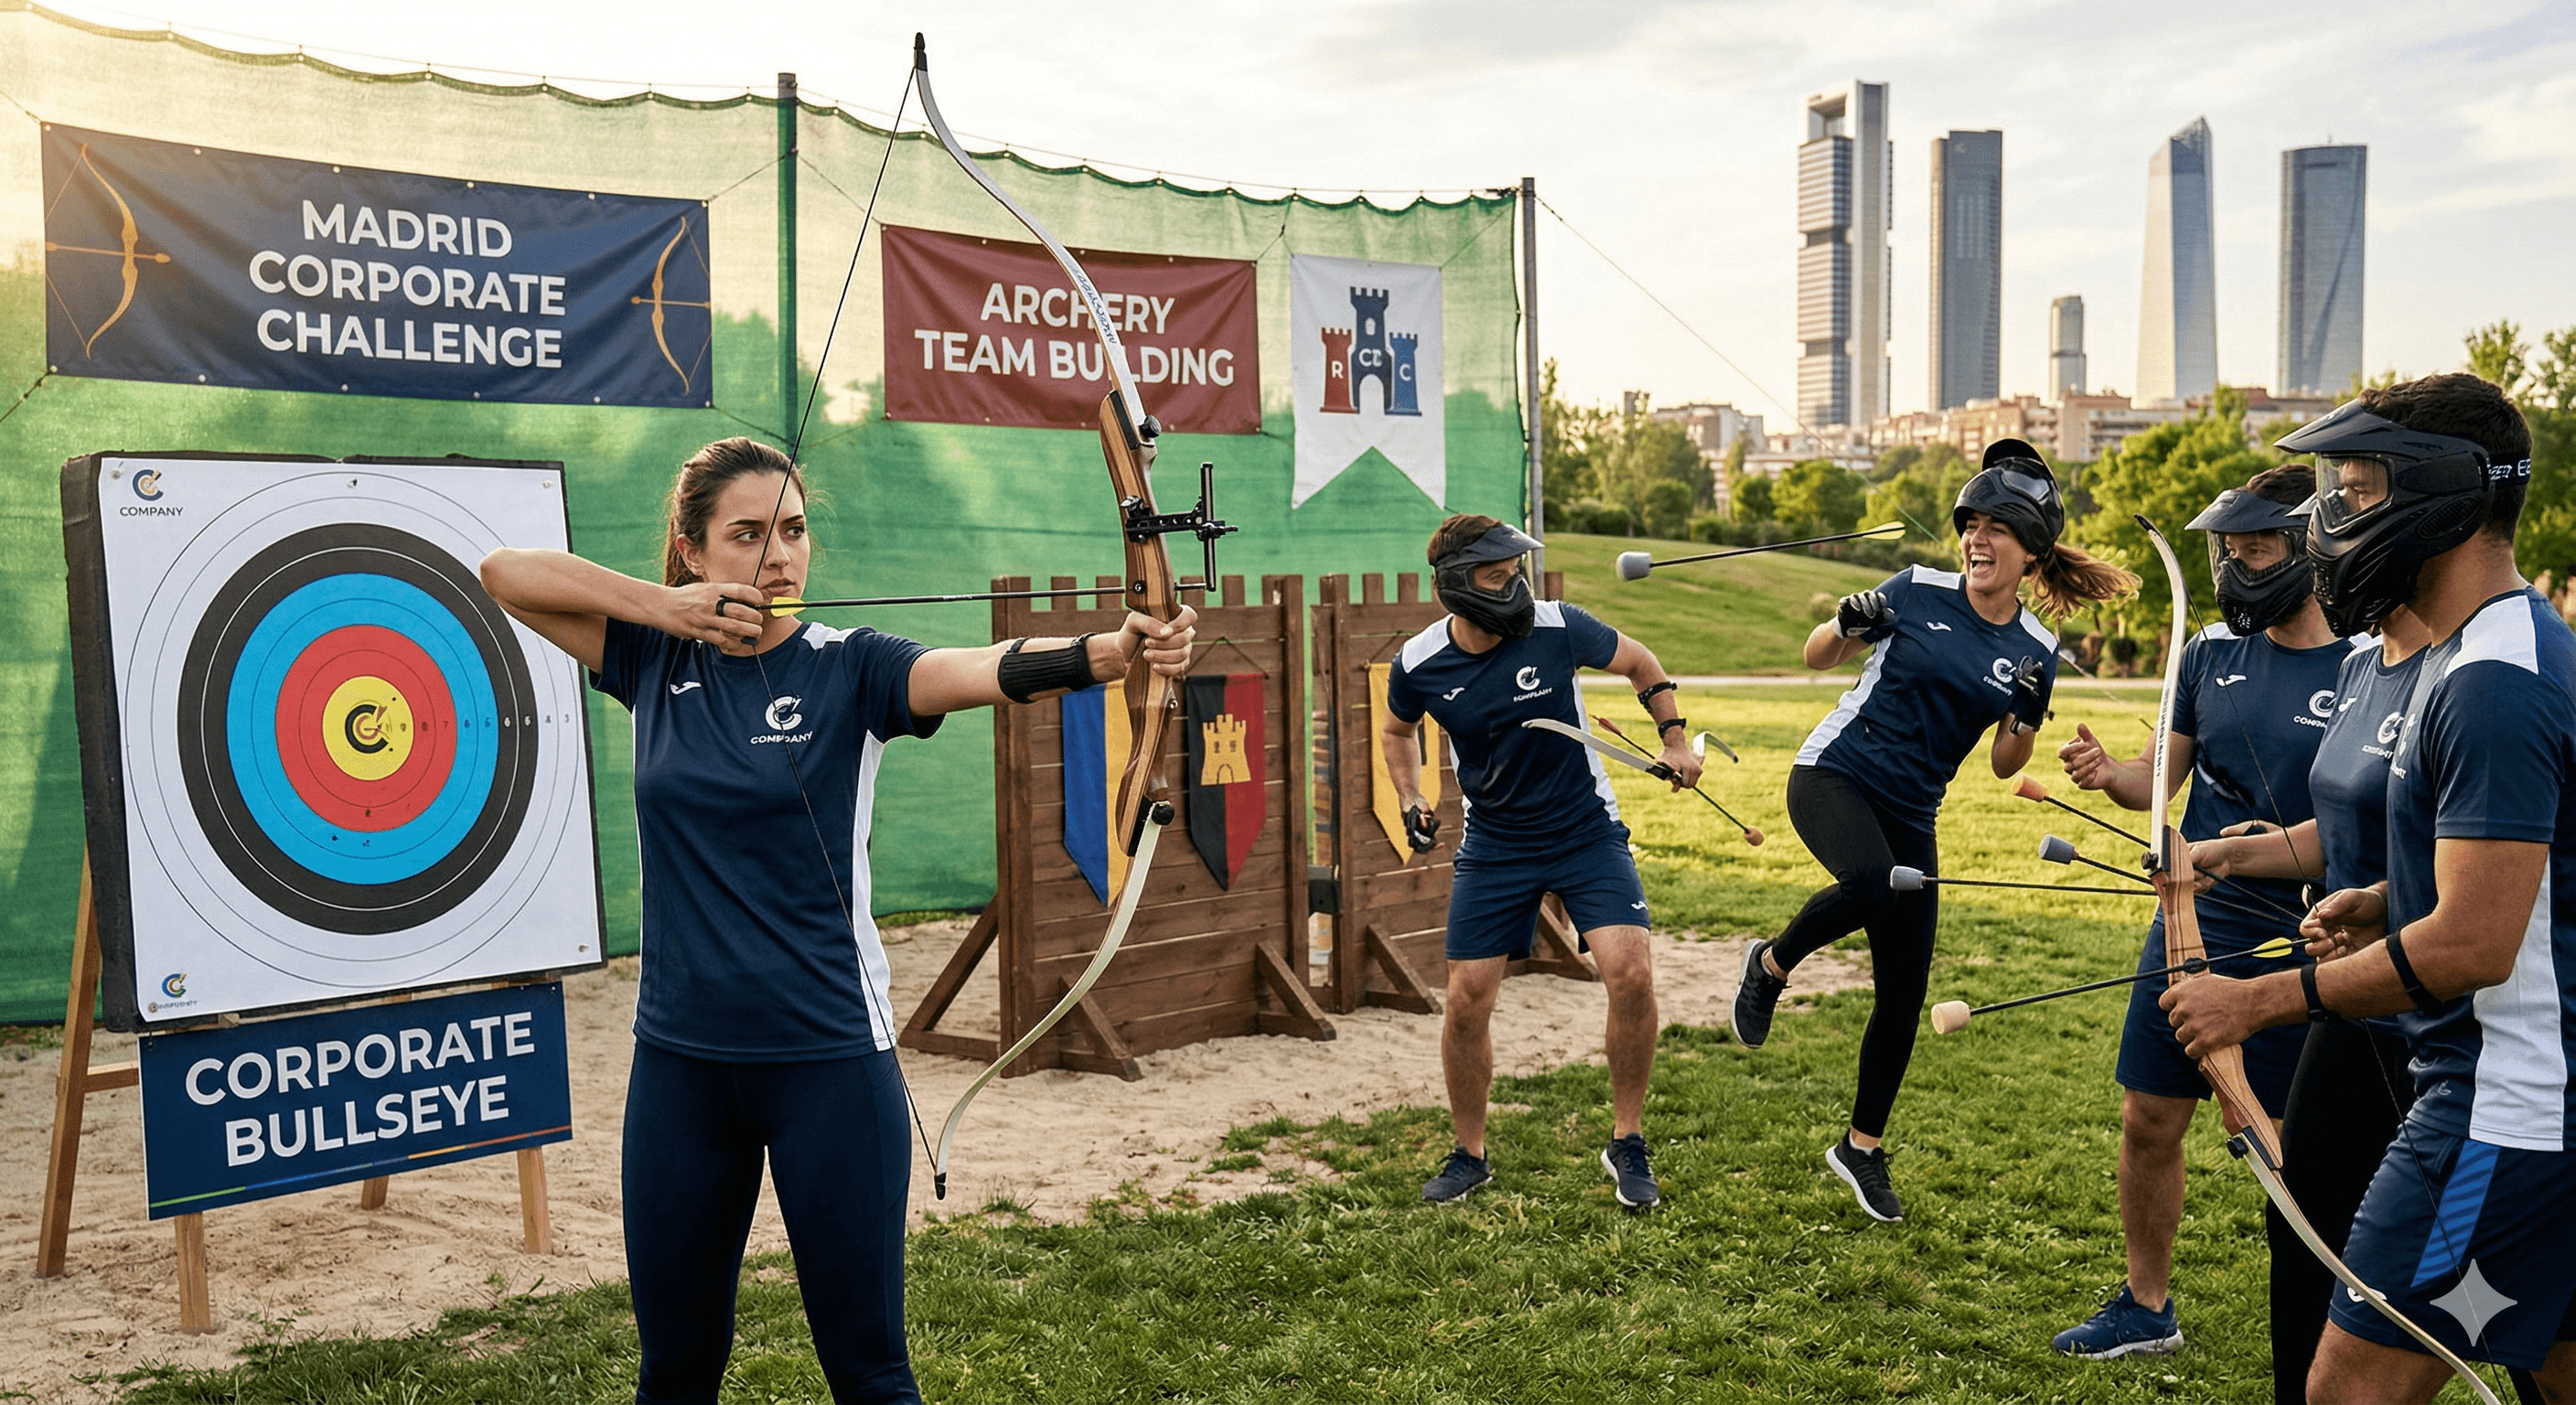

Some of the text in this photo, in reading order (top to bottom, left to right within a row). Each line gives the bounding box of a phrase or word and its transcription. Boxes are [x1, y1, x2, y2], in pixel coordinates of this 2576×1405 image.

[303, 199, 512, 258] MADRID
[249, 251, 565, 316] CORPORATE
[981, 283, 1175, 334] ARCHERY
[257, 309, 563, 368] CHALLENGE
[915, 329, 1234, 386] TEAM BUDING
[1332, 360, 1344, 379] R
[1399, 363, 1411, 381] C
[120, 507, 183, 516] COMPANY
[186, 1012, 534, 1105] CORPORATE
[225, 1075, 509, 1166] BULLSEYE
